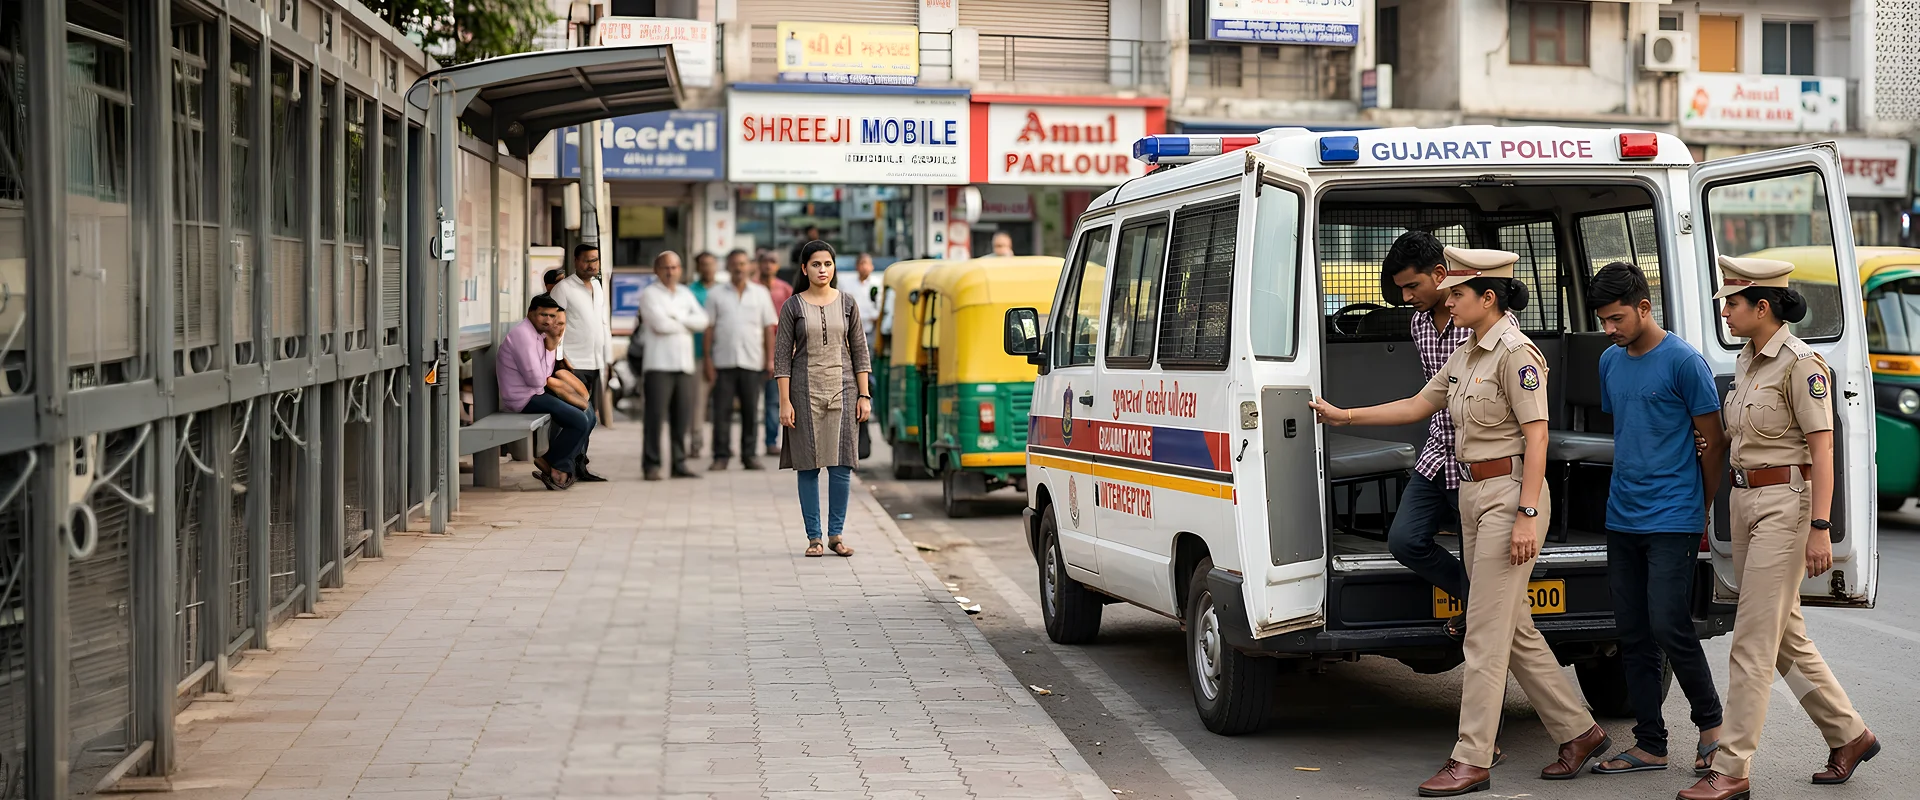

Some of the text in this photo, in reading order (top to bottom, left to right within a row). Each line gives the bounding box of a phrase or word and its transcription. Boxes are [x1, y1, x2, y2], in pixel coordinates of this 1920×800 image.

[742, 116, 957, 145] SHREEJI MOBILE
[1017, 110, 1117, 142] Amul
[1371, 140, 1593, 161] GUJARAT POLICE
[1005, 153, 1130, 175] PARLOUR
